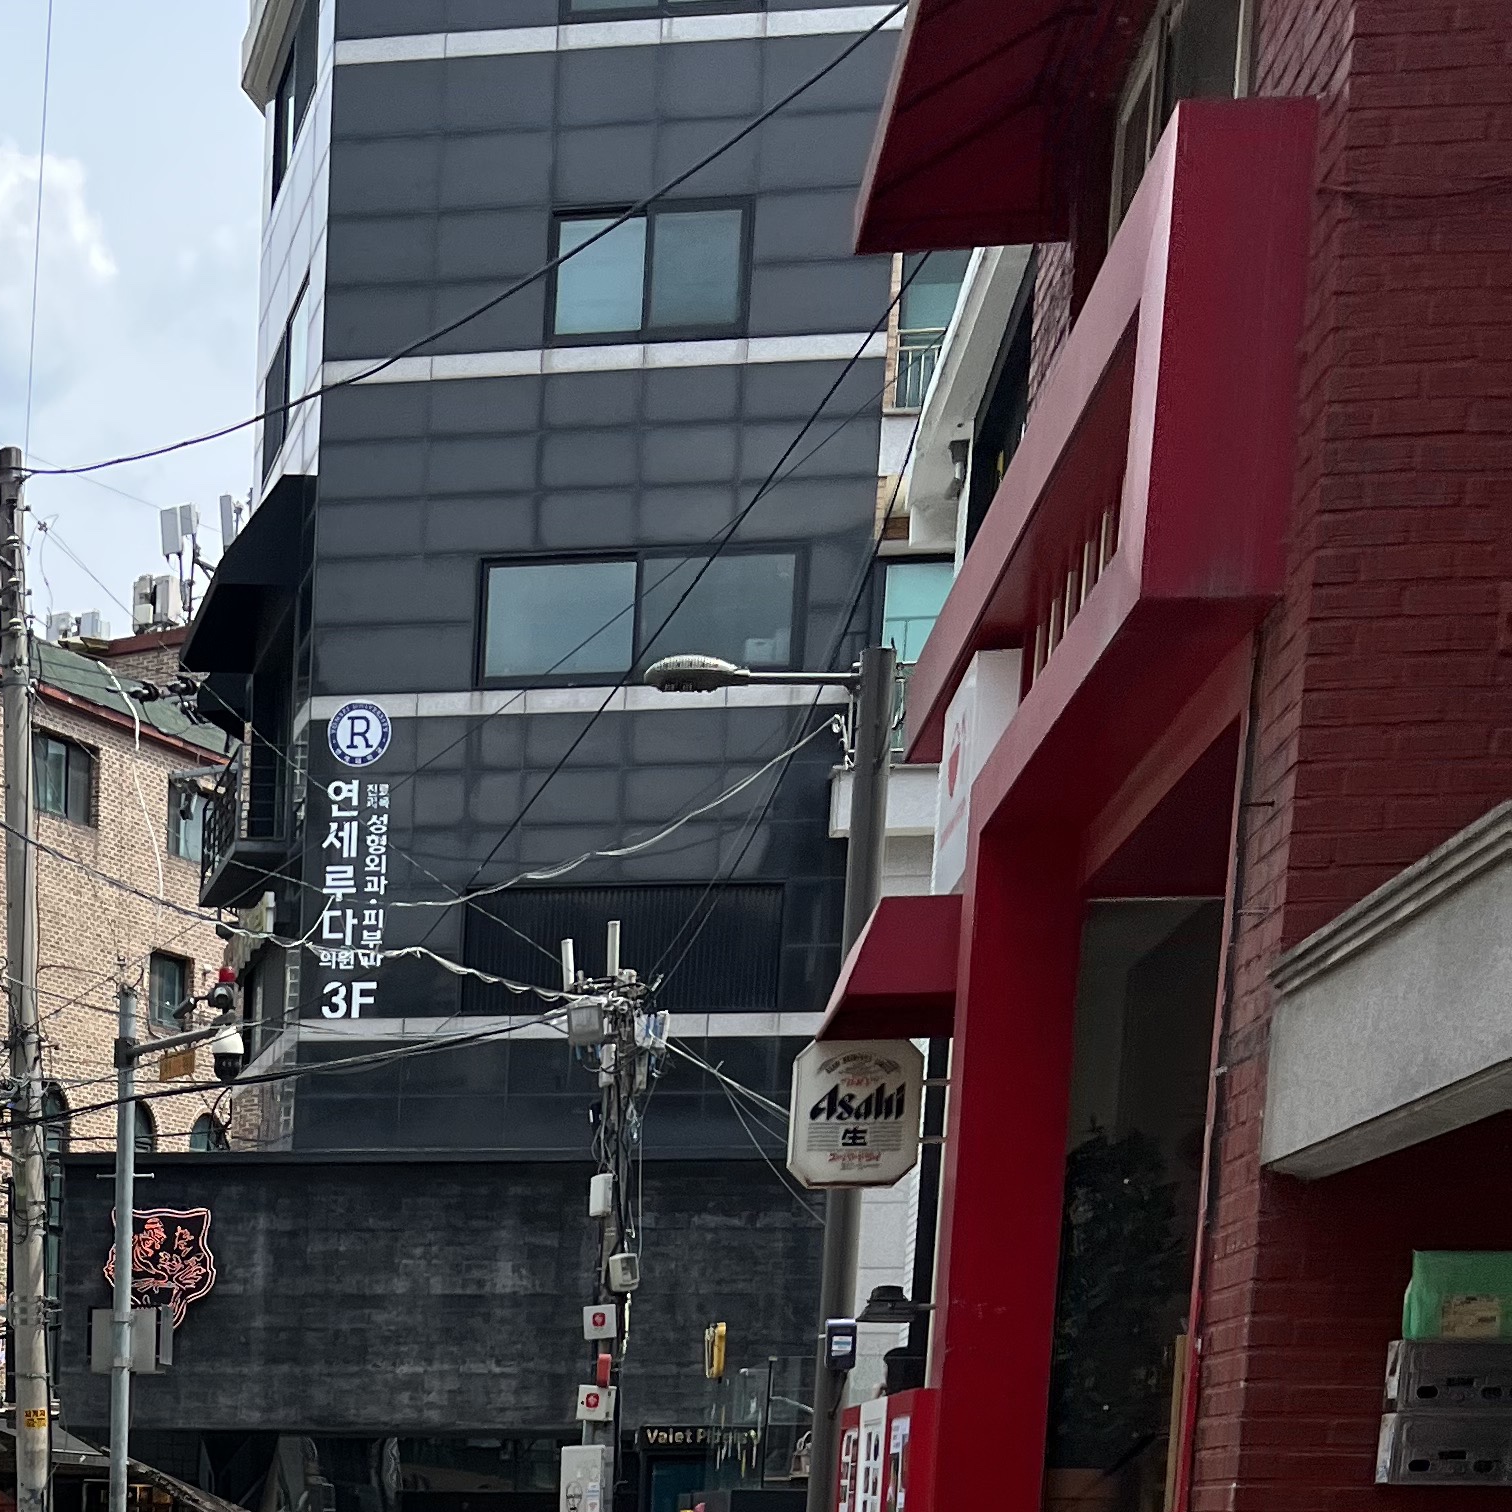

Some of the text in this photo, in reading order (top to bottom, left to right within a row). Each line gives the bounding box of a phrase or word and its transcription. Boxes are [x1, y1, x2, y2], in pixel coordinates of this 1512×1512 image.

[346, 716, 373, 749] R
[322, 779, 359, 946] 연세루다
[321, 981, 378, 1019] 3F
[809, 1081, 906, 1121] Asahi
[841, 1125, 868, 1147] 生
[646, 1427, 693, 1444] Valet
